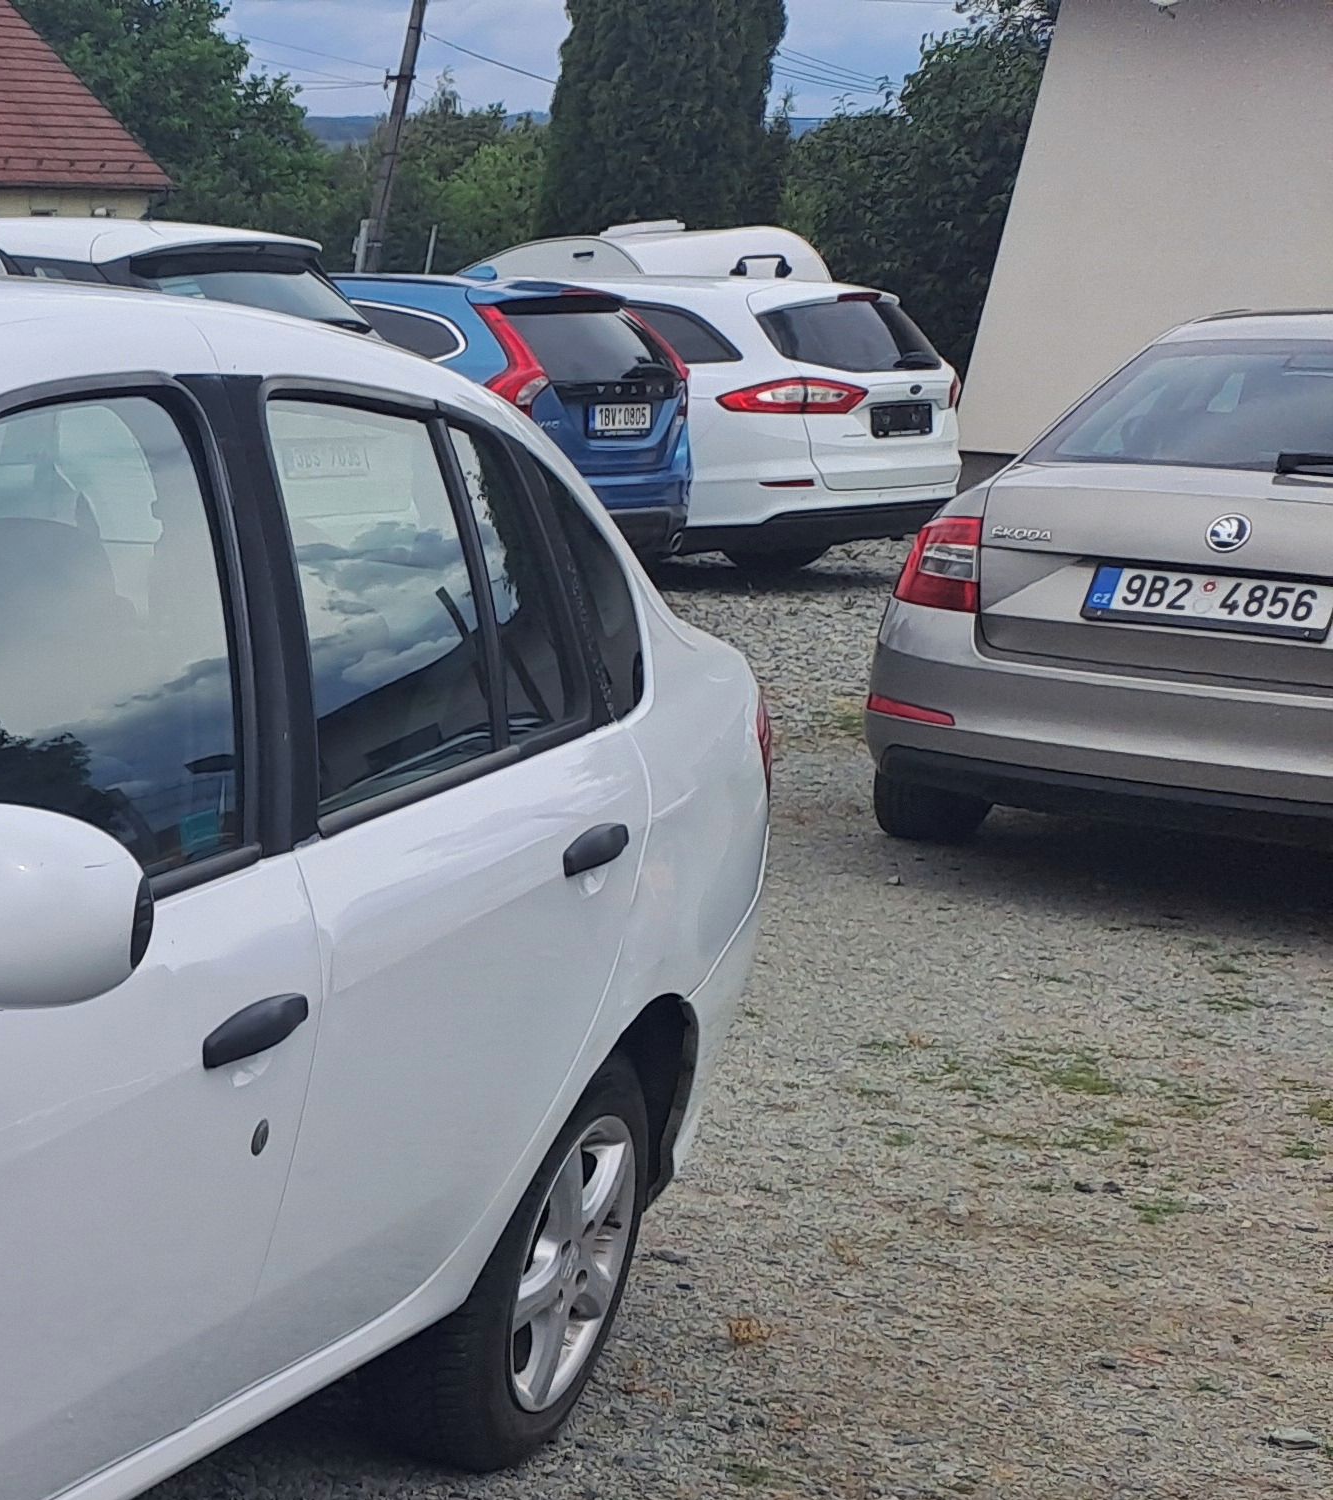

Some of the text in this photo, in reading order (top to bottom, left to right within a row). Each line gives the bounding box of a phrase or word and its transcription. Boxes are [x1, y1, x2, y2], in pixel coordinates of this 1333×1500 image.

[596, 384, 665, 395] VOLVO
[598, 406, 647, 427] 1BV 0805
[1092, 591, 1110, 604] CZ
[1121, 573, 1318, 622] 9B2 4856
